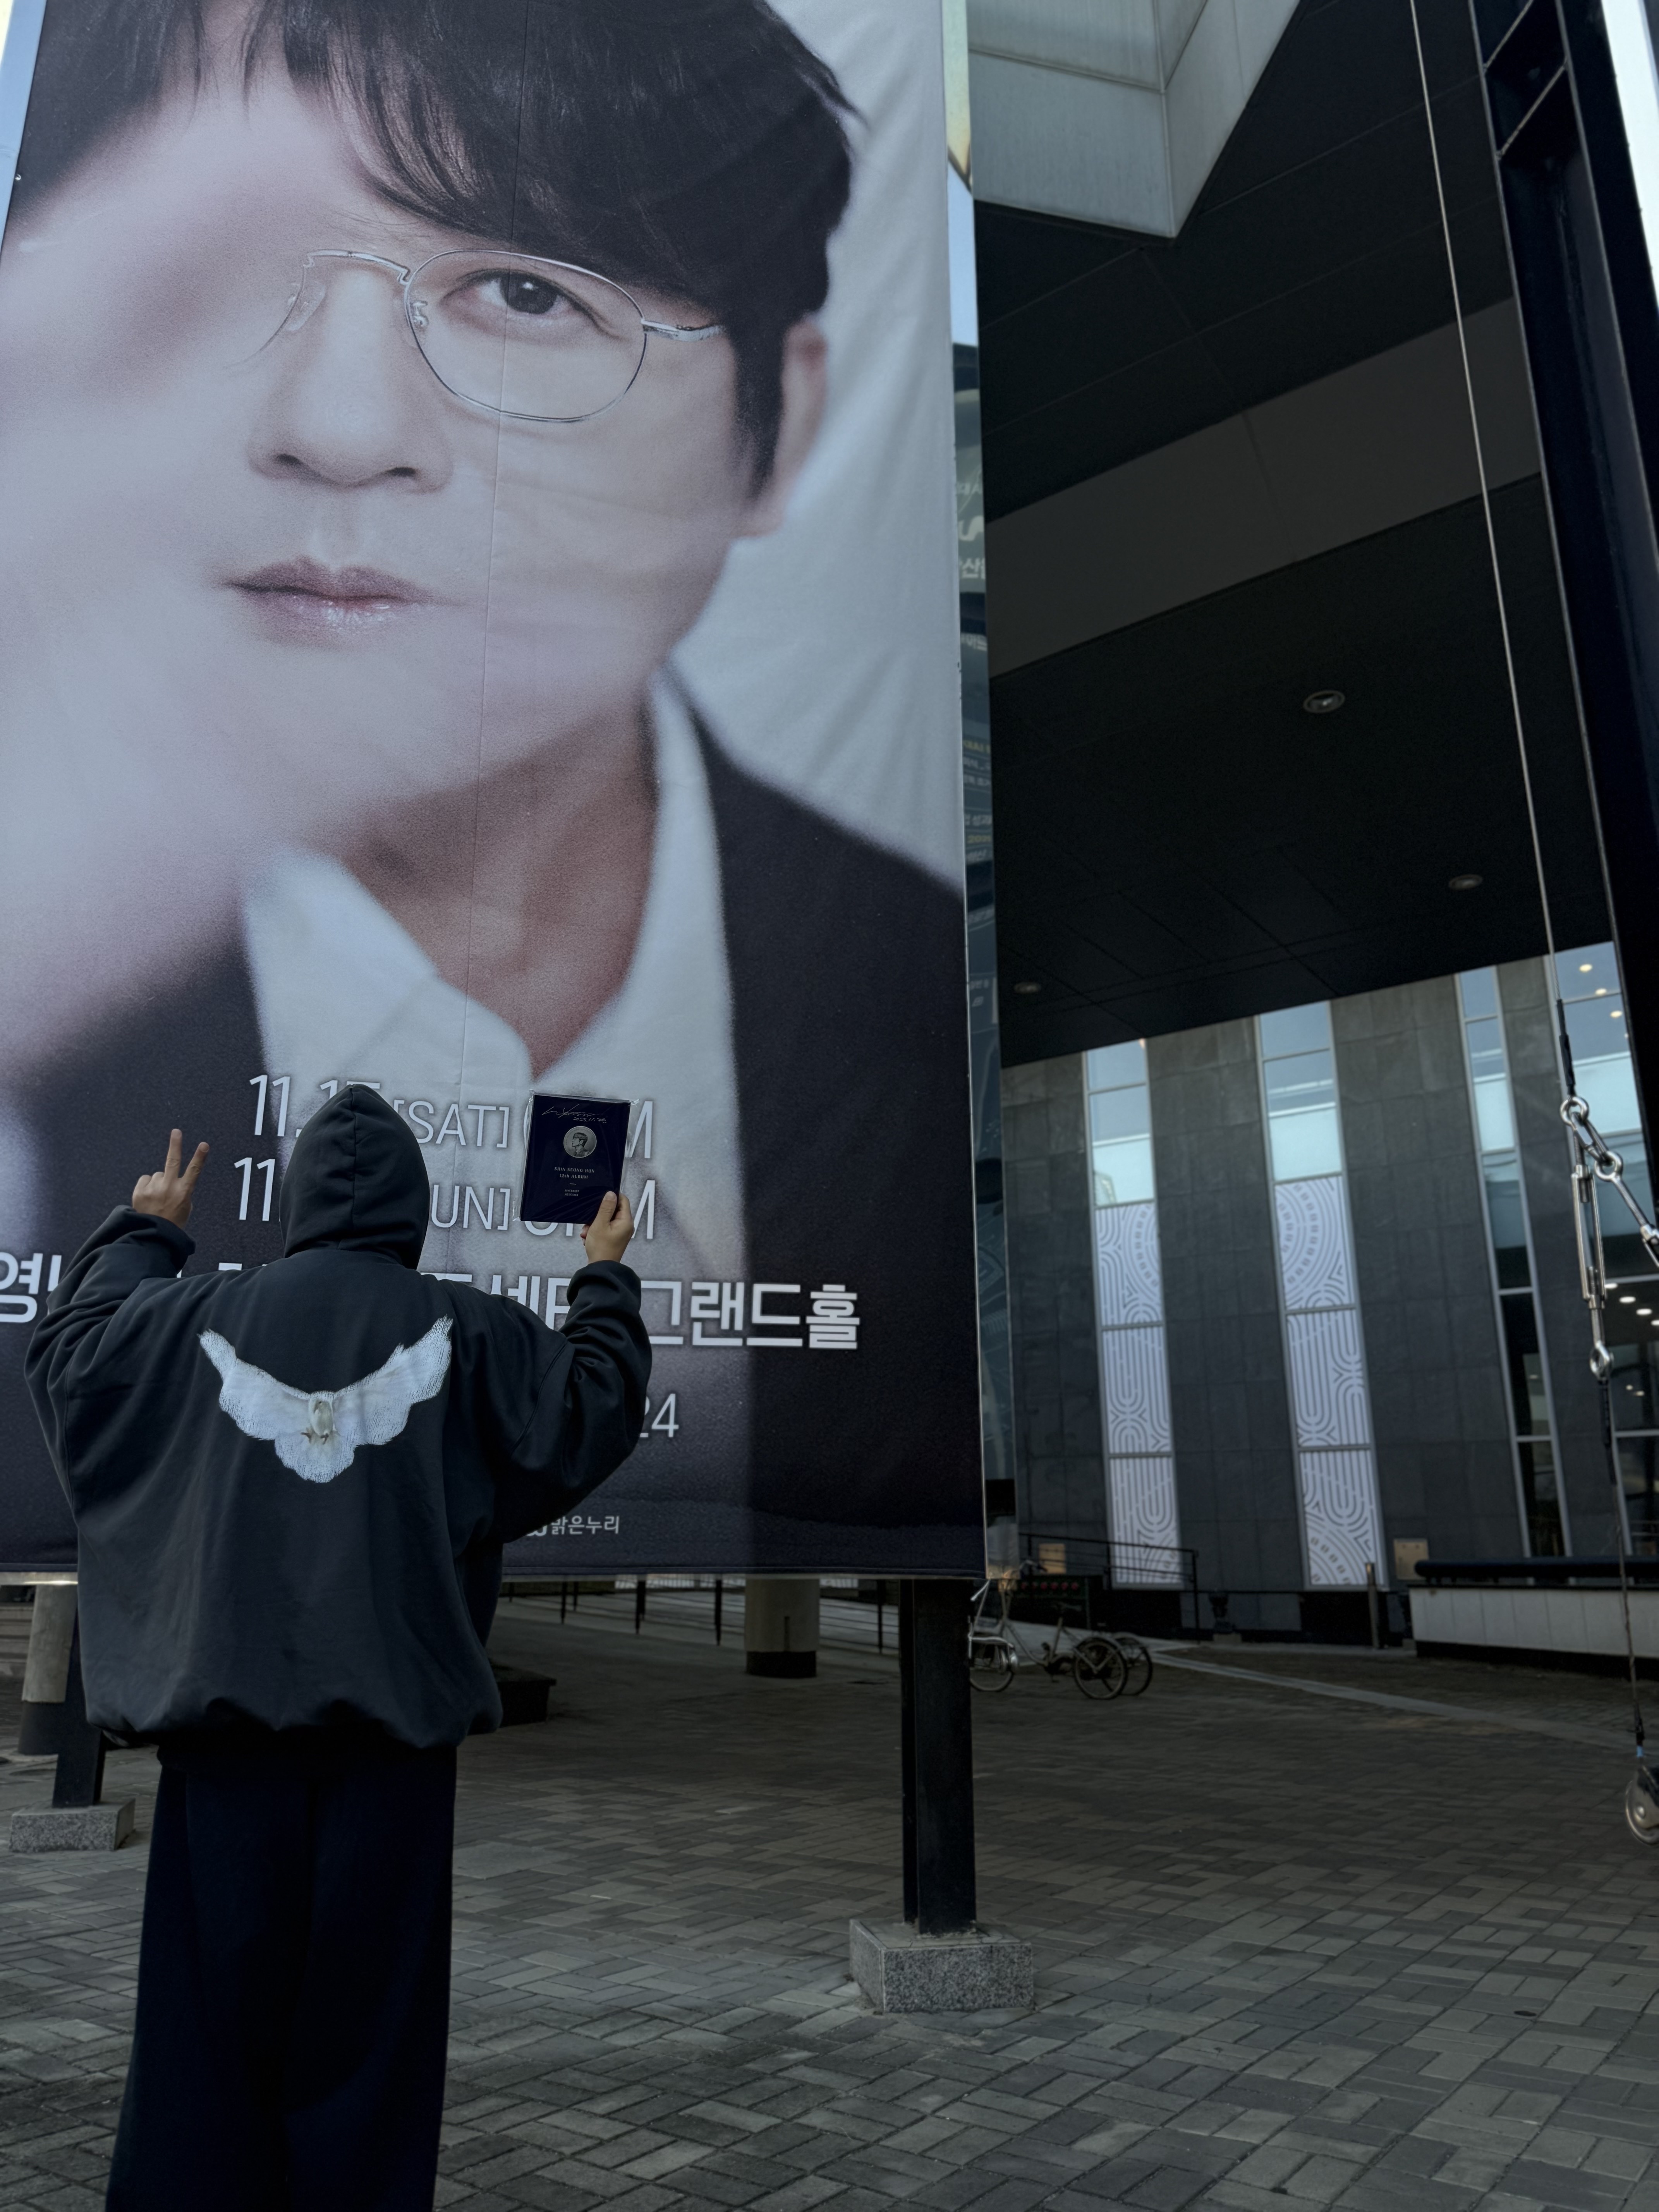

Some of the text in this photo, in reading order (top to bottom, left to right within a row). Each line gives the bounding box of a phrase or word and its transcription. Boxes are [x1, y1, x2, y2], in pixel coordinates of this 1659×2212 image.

[431, 1184, 511, 1231] UN]
[641, 1280, 860, 1350] 그랜드홀
[551, 1516, 620, 1535] 맑은누리
